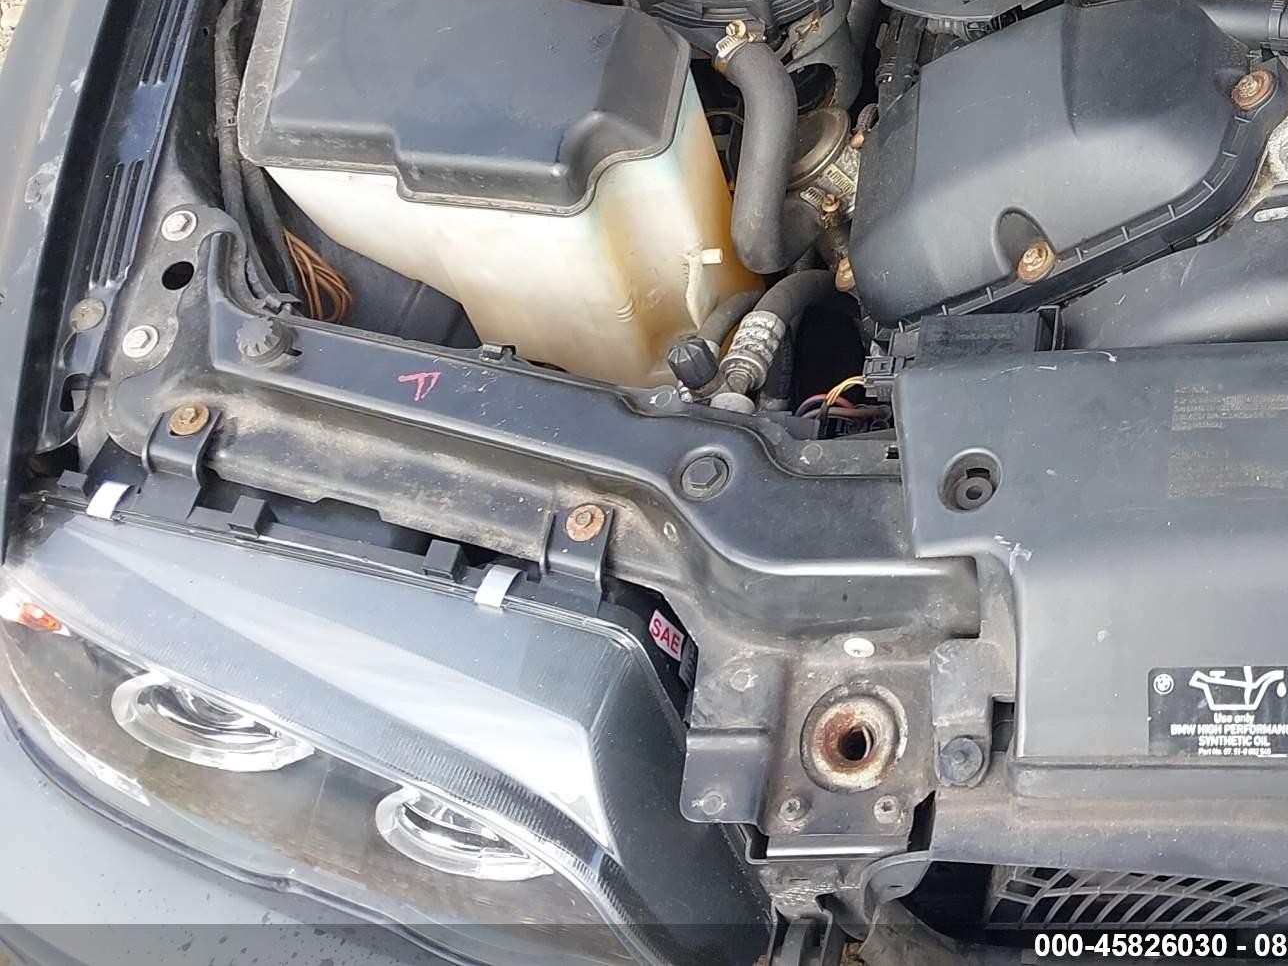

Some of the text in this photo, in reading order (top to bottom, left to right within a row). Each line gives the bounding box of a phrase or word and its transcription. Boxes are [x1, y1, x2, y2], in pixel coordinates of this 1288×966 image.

[651, 618, 680, 654] SAE
[1213, 713, 1255, 725] Use only
[1170, 724, 1196, 735] BMW
[1197, 724, 1222, 735] HIGH
[1198, 735, 1271, 746] SYNTHETIC OIL
